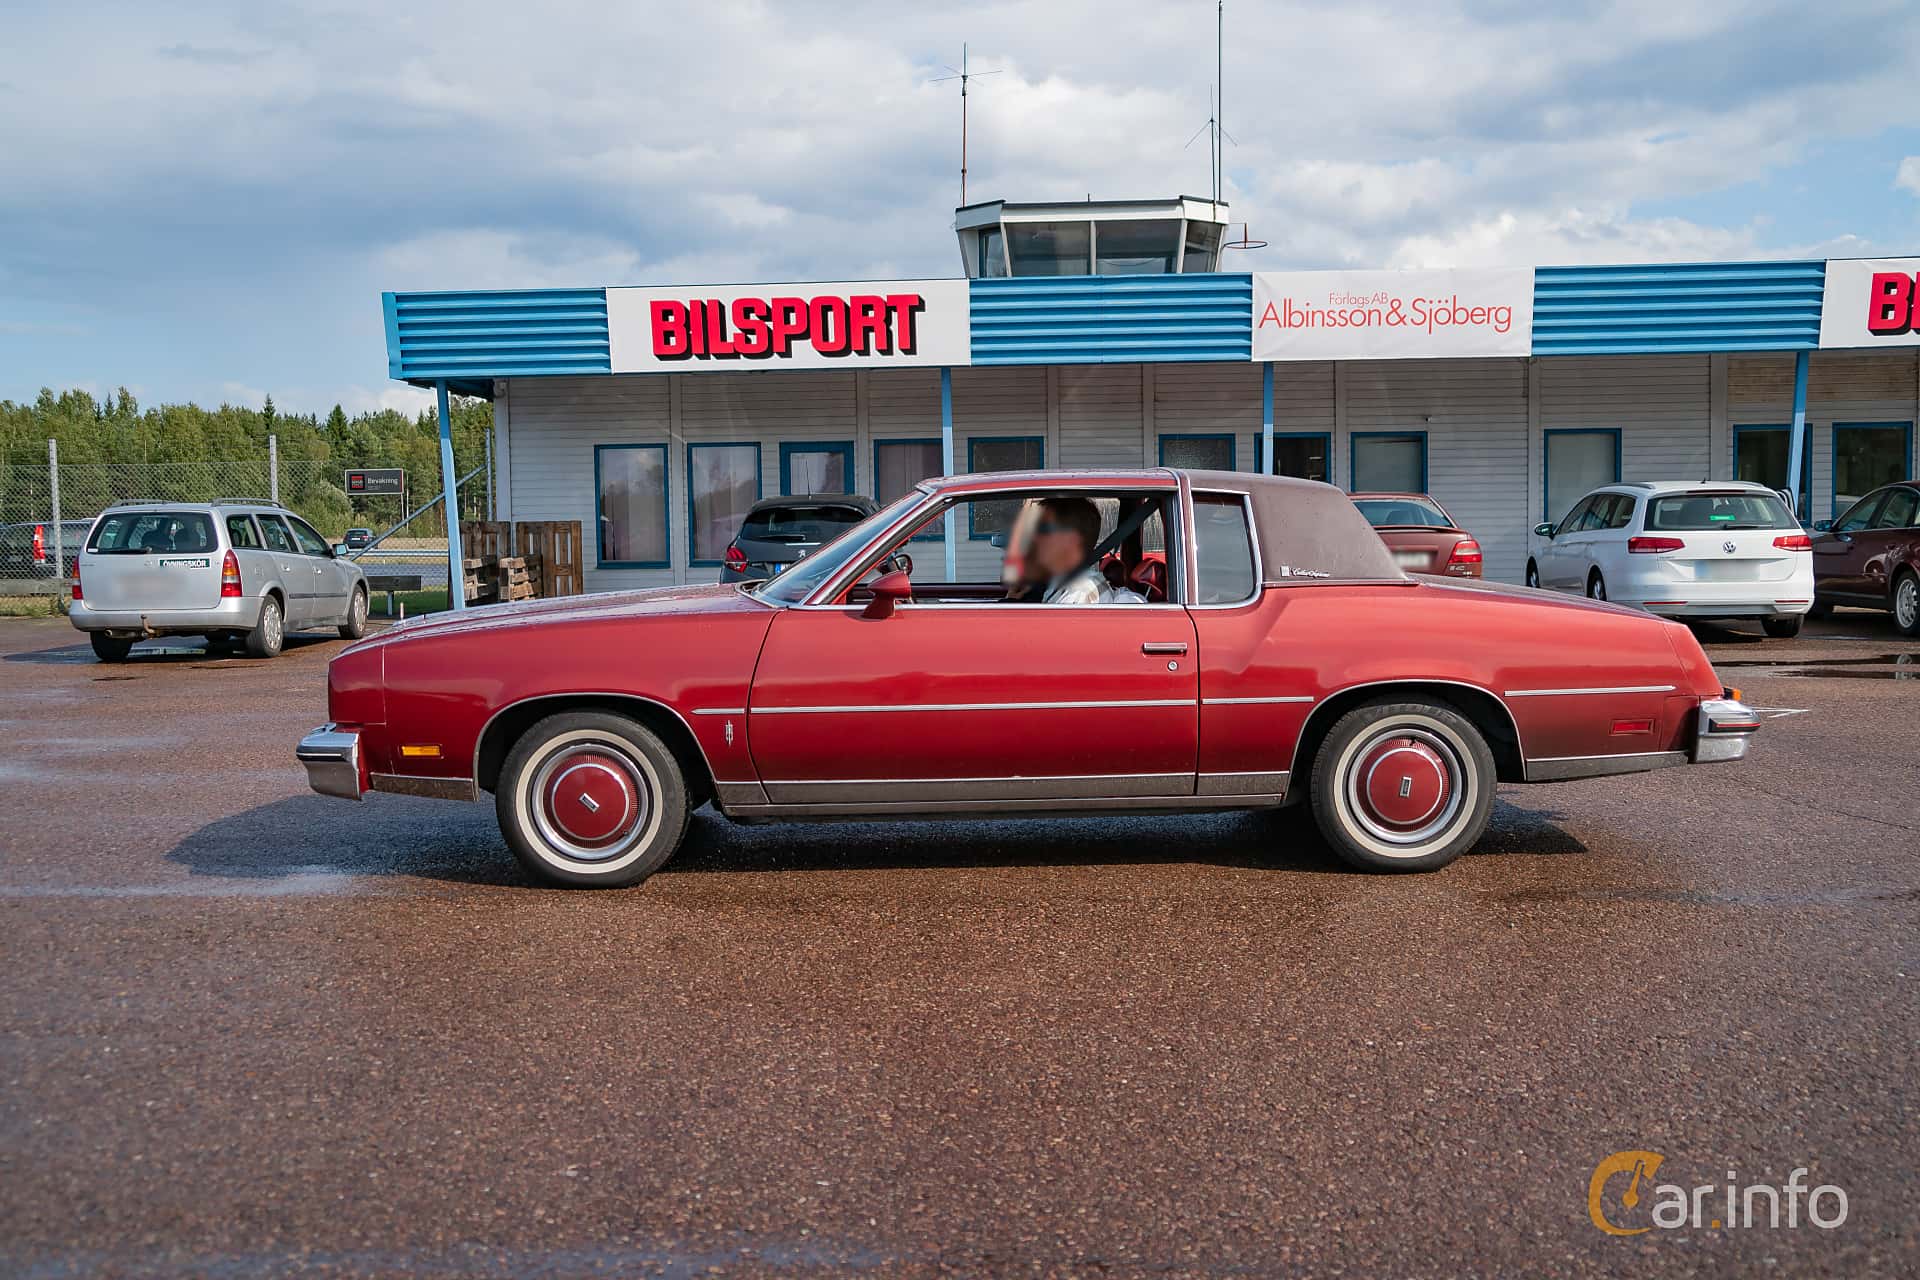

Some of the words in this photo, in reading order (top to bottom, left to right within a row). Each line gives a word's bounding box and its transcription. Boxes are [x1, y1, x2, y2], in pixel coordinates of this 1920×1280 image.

[1258, 298, 1382, 329] Albinsson
[1385, 299, 1407, 327] &
[1410, 295, 1512, 335] Sjöberg
[1329, 293, 1370, 306] Förlags
[1371, 292, 1389, 304] AB
[650, 294, 925, 361] BILSPORT
